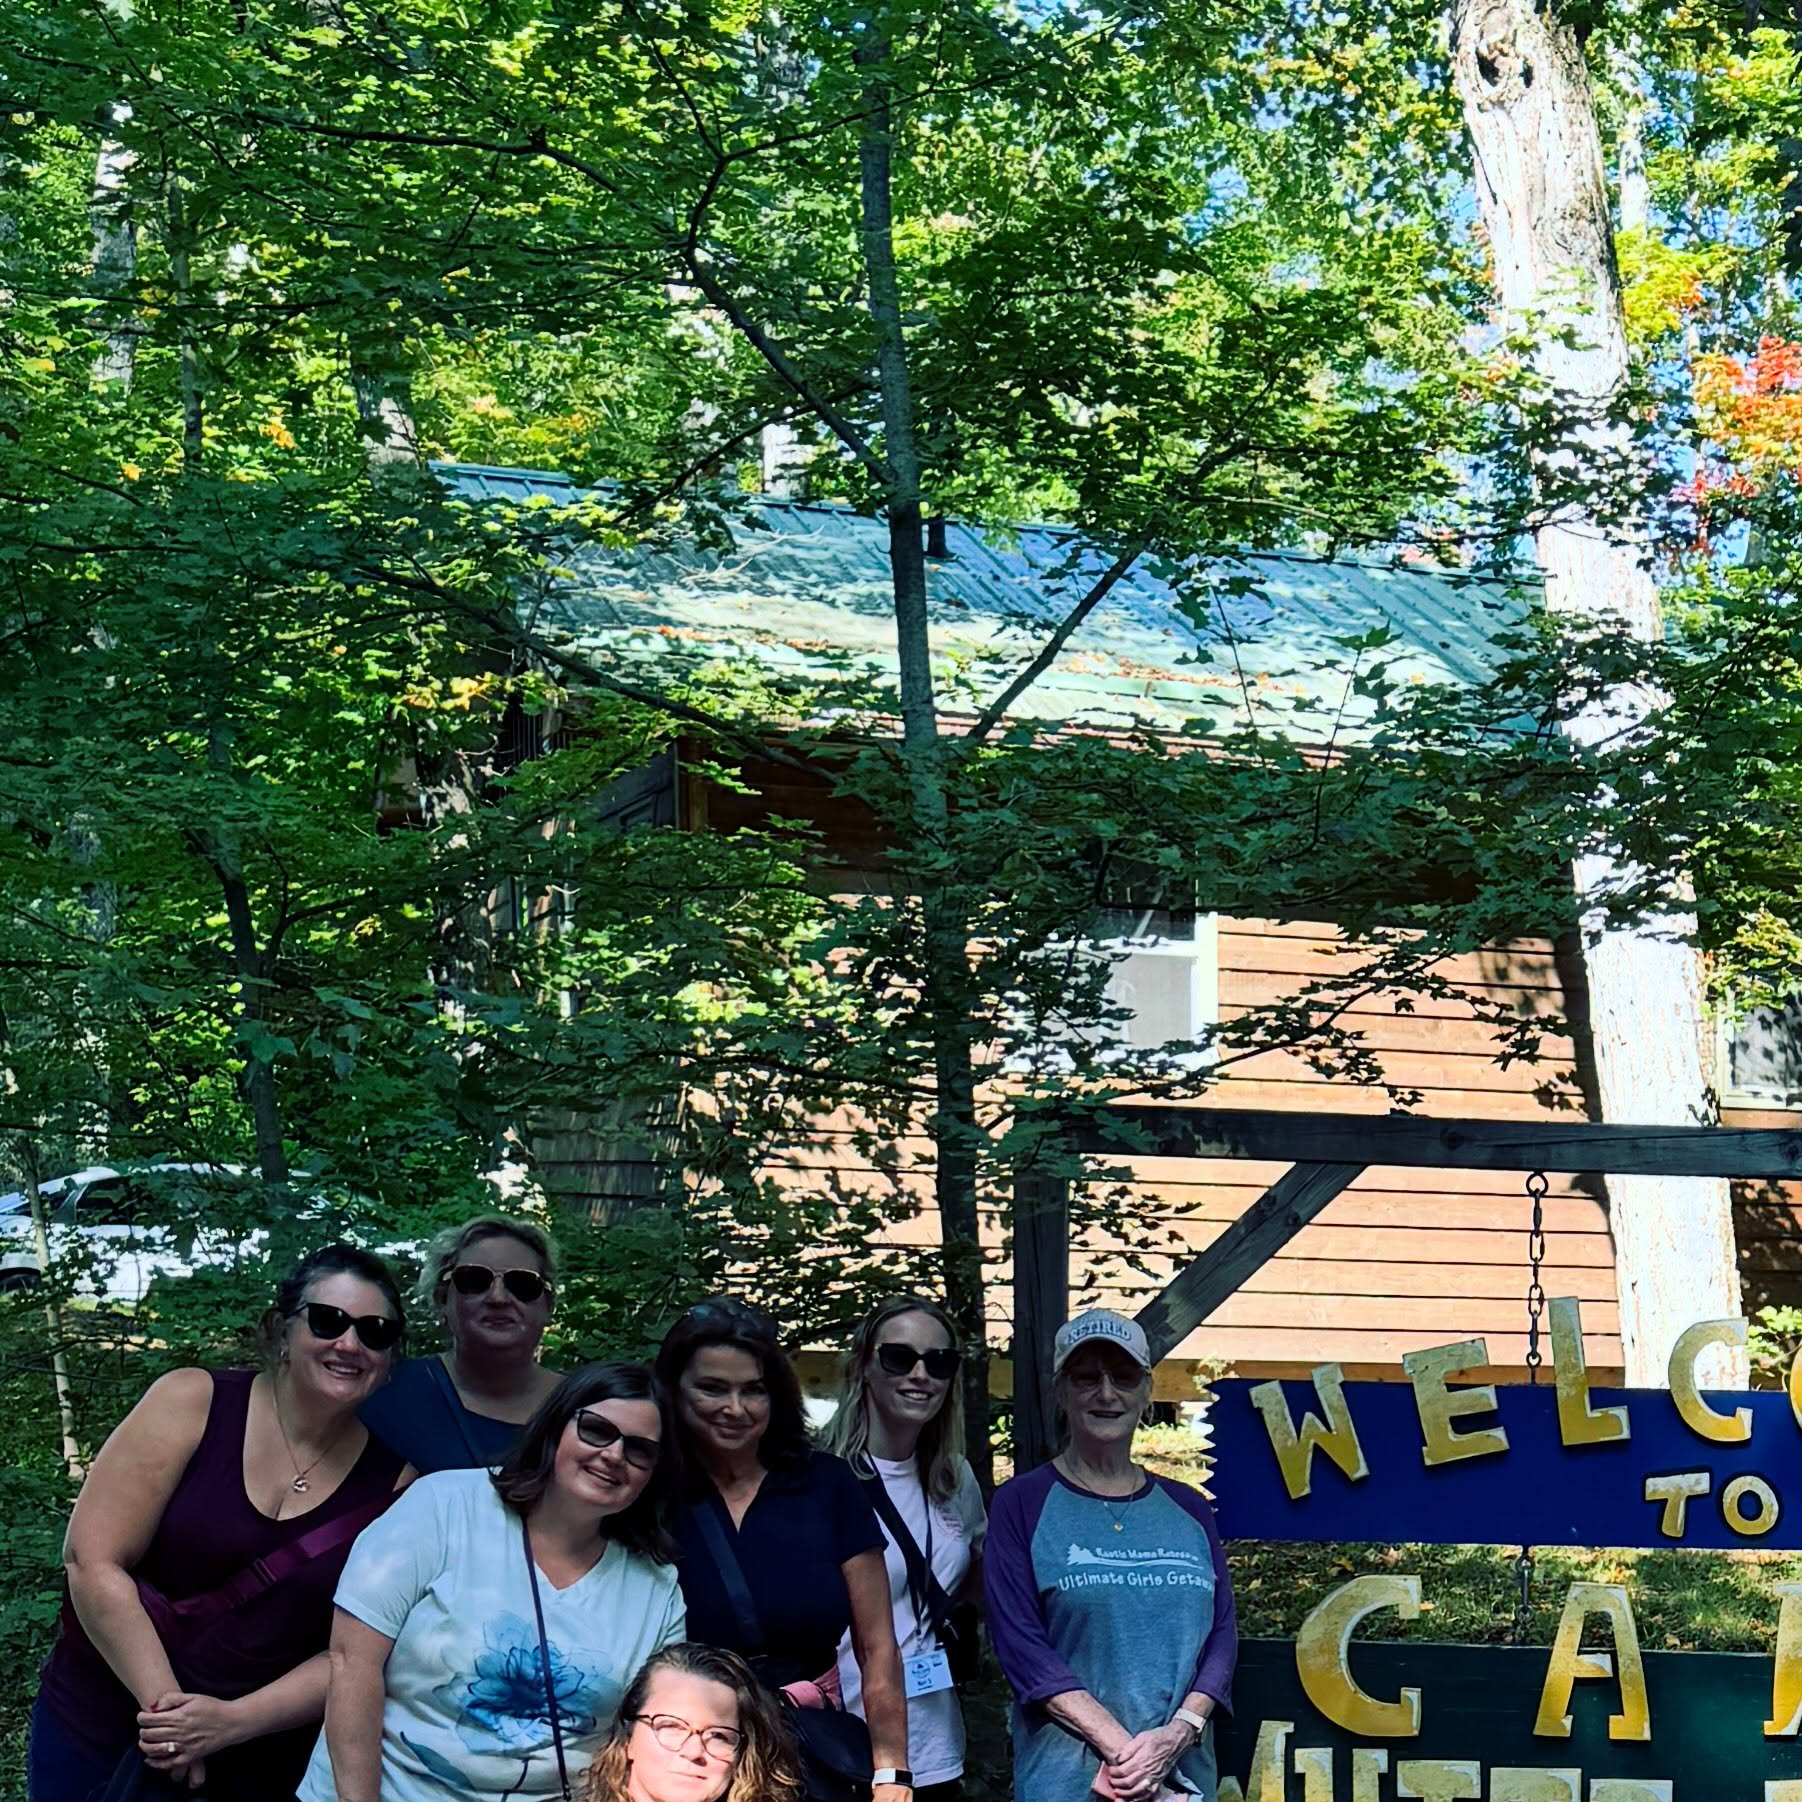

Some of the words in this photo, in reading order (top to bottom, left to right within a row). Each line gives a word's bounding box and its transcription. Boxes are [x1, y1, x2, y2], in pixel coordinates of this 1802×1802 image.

[1067, 1319, 1131, 1345] RETIRED
[1644, 1472, 1781, 1539] TO
[1058, 1571, 1124, 1591] Ultimate
[1126, 1571, 1163, 1587] Girls
